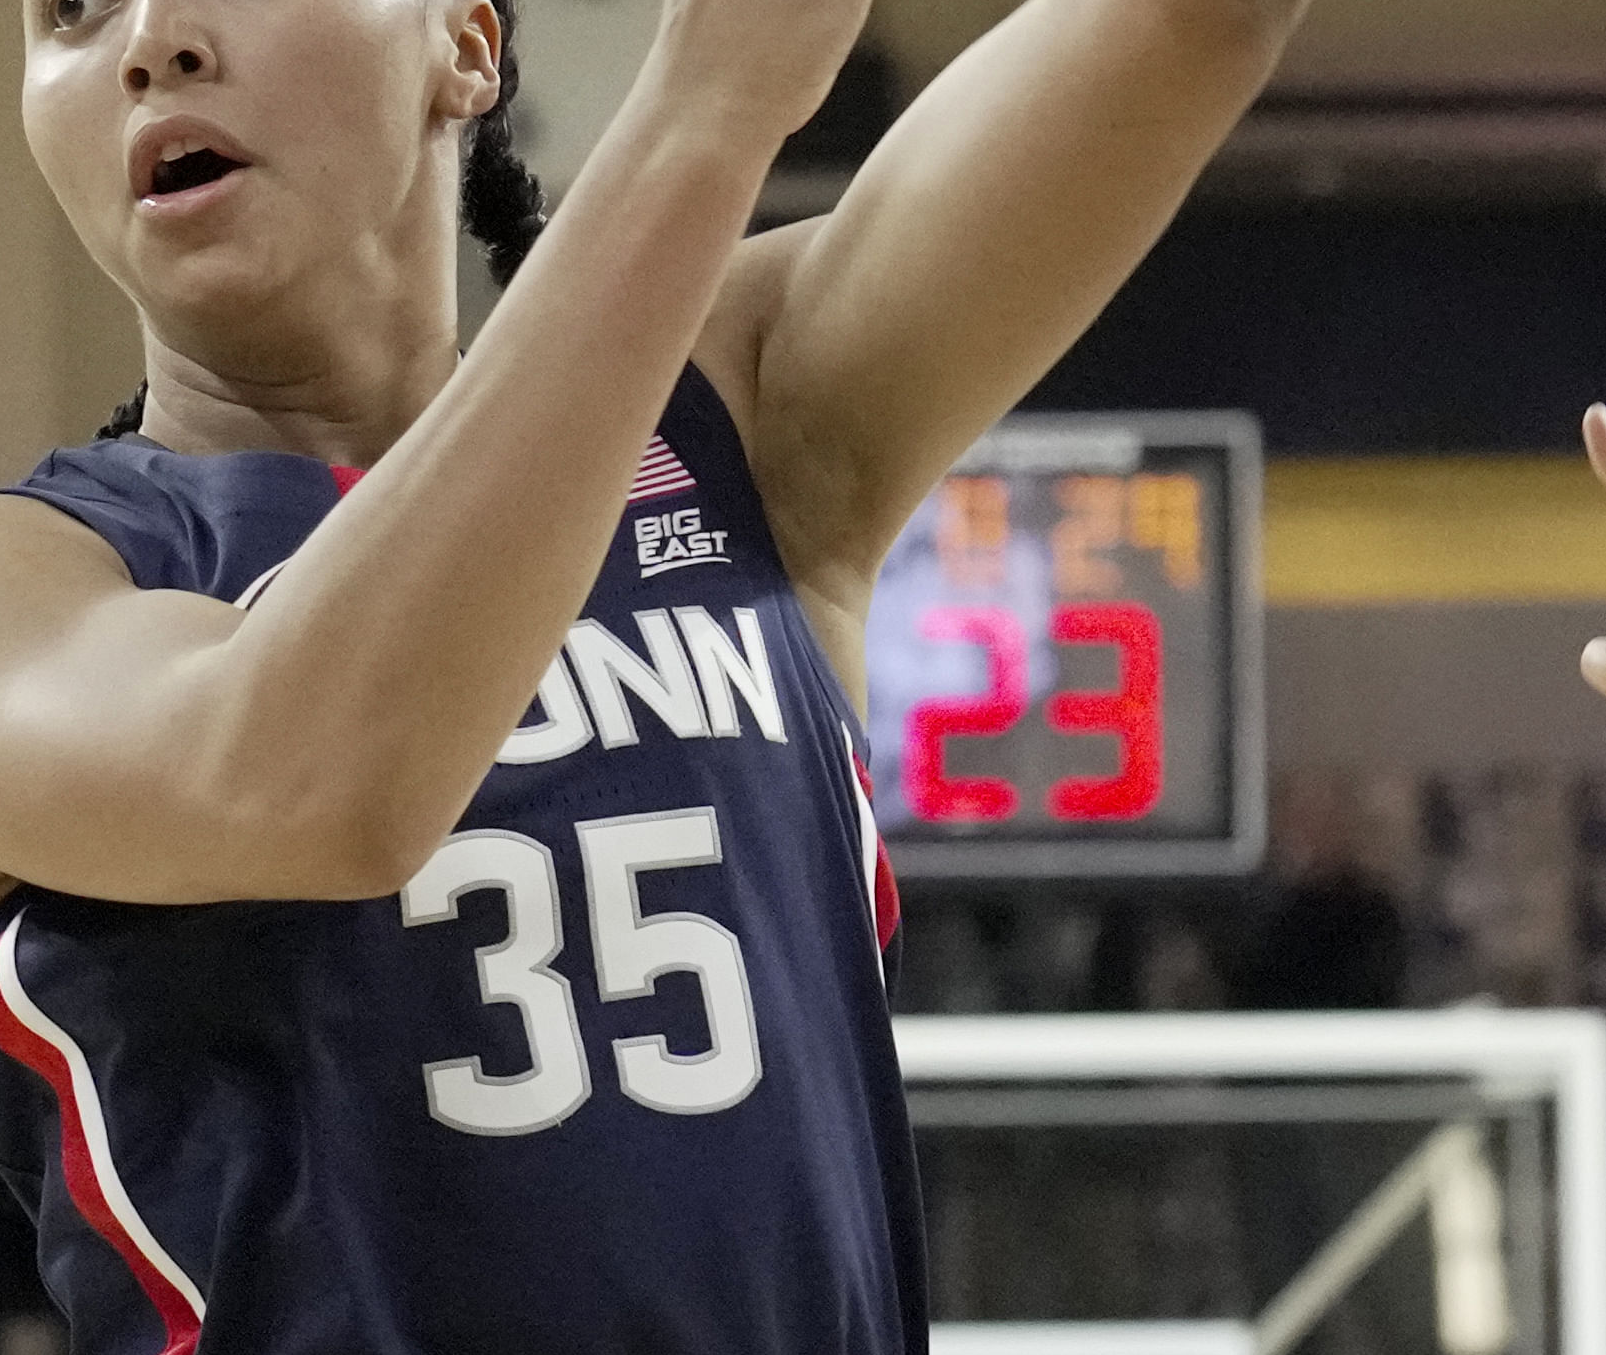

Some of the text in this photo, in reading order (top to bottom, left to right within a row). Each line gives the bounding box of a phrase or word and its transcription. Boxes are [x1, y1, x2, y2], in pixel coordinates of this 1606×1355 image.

[635, 507, 701, 541] BIG
[638, 530, 728, 566] EAST
[900, 602, 1163, 823] 23
[400, 805, 763, 1136] 35
